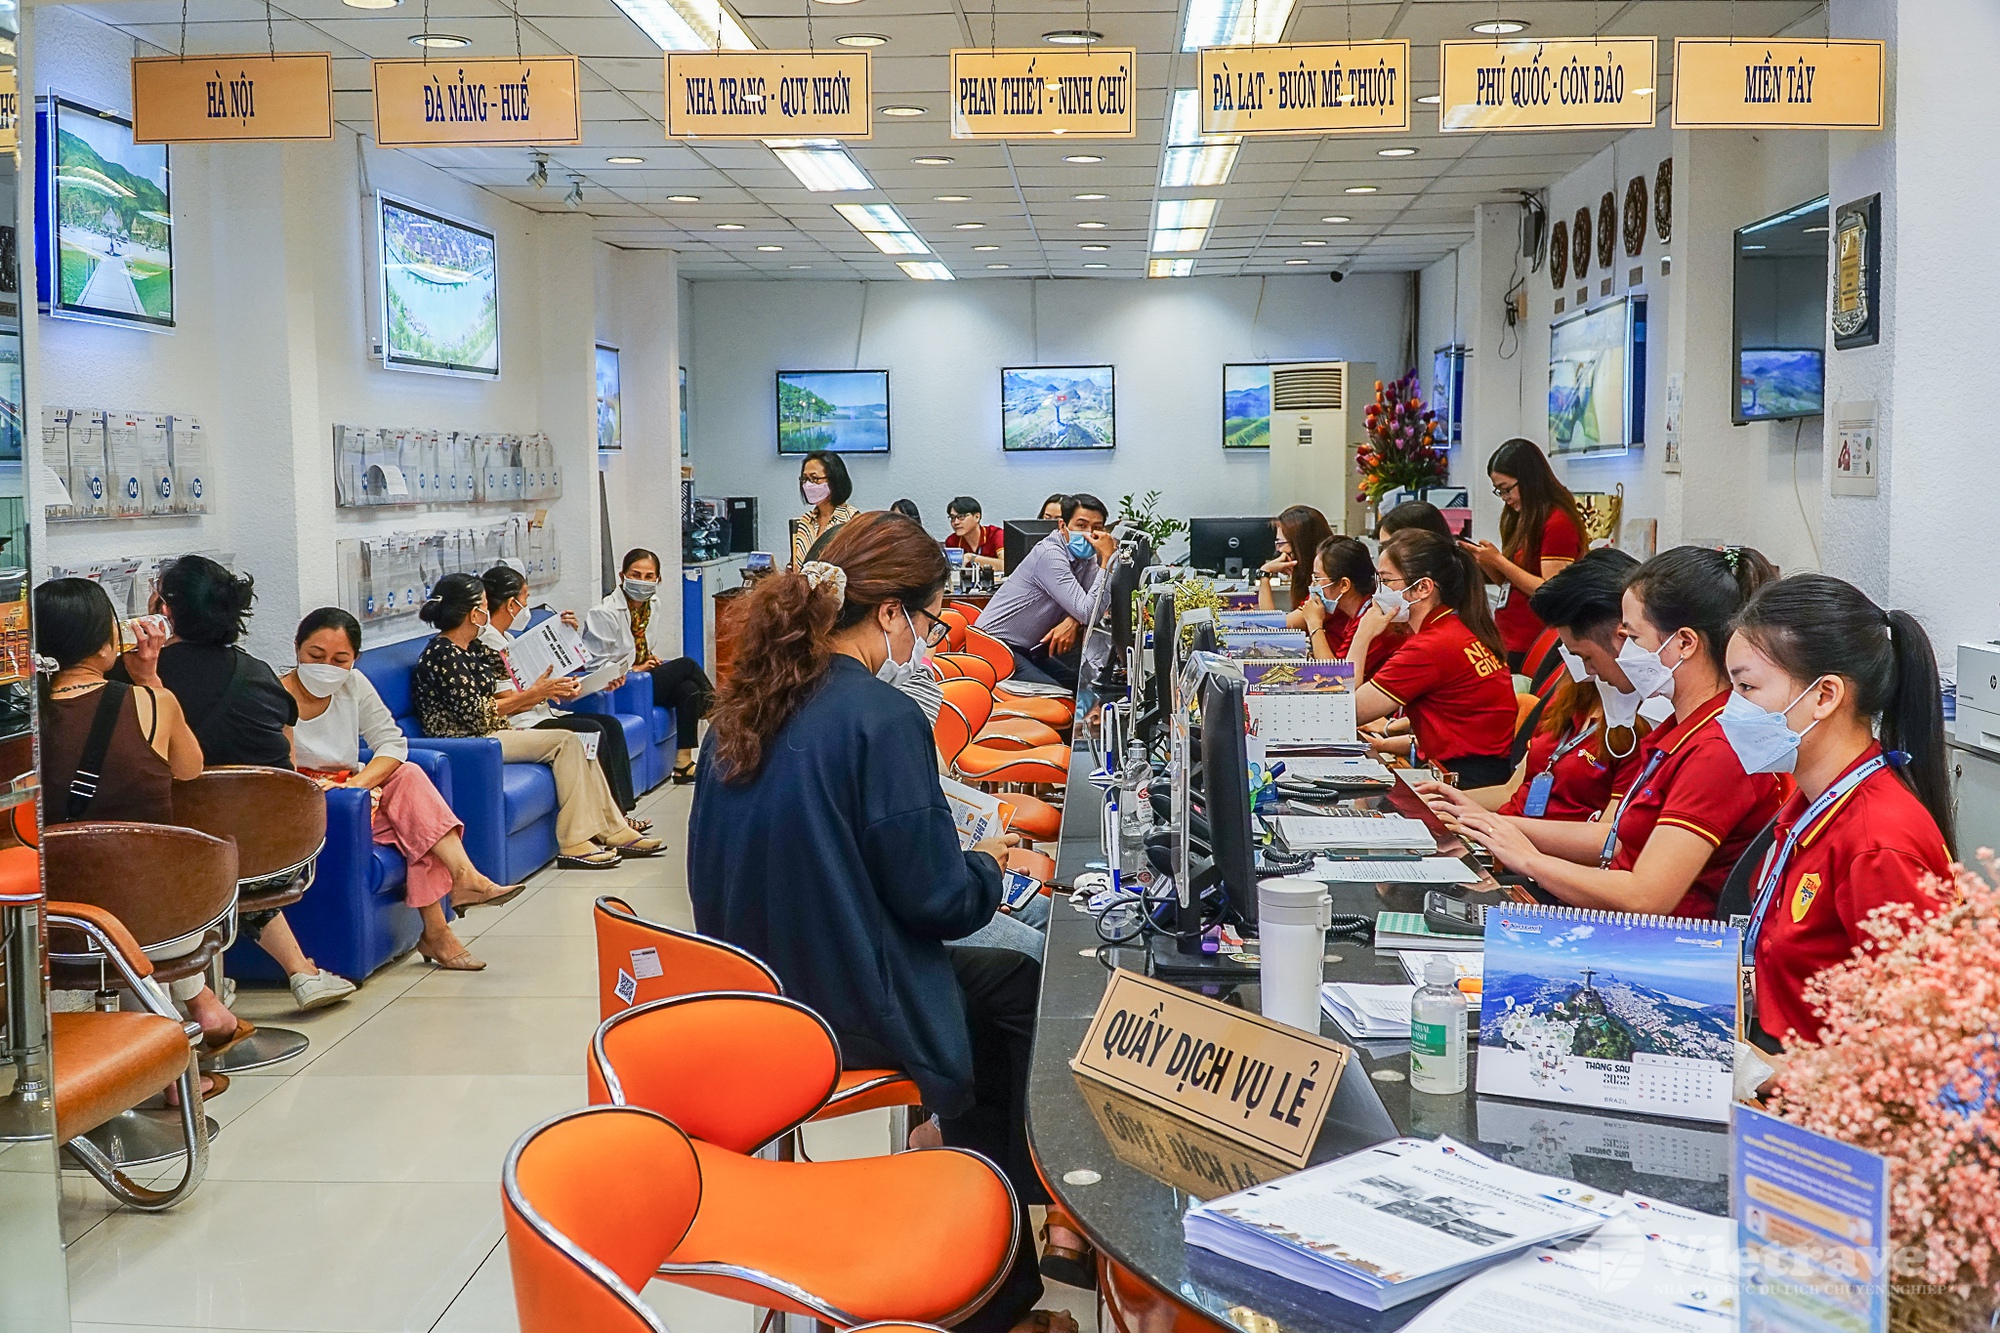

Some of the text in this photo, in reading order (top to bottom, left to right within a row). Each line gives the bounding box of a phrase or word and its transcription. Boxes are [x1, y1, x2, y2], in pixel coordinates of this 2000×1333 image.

[206, 70, 255, 127] HÀ NỘI
[424, 74, 446, 122] ĐÀ
[500, 68, 531, 121] HUẾ
[686, 77, 717, 115] NHA
[719, 77, 767, 115] TRANG
[780, 77, 809, 118] QUY
[812, 70, 851, 115] NHƠN
[960, 77, 997, 115] PHAN
[1001, 57, 1045, 115] THIẾT
[1058, 77, 1093, 114] NINH
[1213, 62, 1234, 110] ĐÀ
[1237, 72, 1266, 119] LẠT
[1278, 60, 1317, 109] BUÔN
[1321, 59, 1343, 107] MÊ
[1347, 57, 1397, 116] THUỘT
[1476, 55, 1506, 106] PHÚ
[1510, 43, 1551, 108] QUỐC
[1560, 55, 1590, 104] CÔN
[1594, 51, 1624, 103] ĐẢO
[1744, 50, 1816, 103] MIỀN TÂY
[92, 480, 101, 495] 03
[129, 480, 138, 495] 04
[162, 480, 170, 494] 05
[194, 481, 202, 495] 06
[972, 817, 988, 843] EMS
[1103, 1002, 1320, 1128] QUẦY DỊCH VỤ LẺ
[1603, 1073, 1630, 1086] 2022
[1604, 1097, 1629, 1105] BRAZIL
